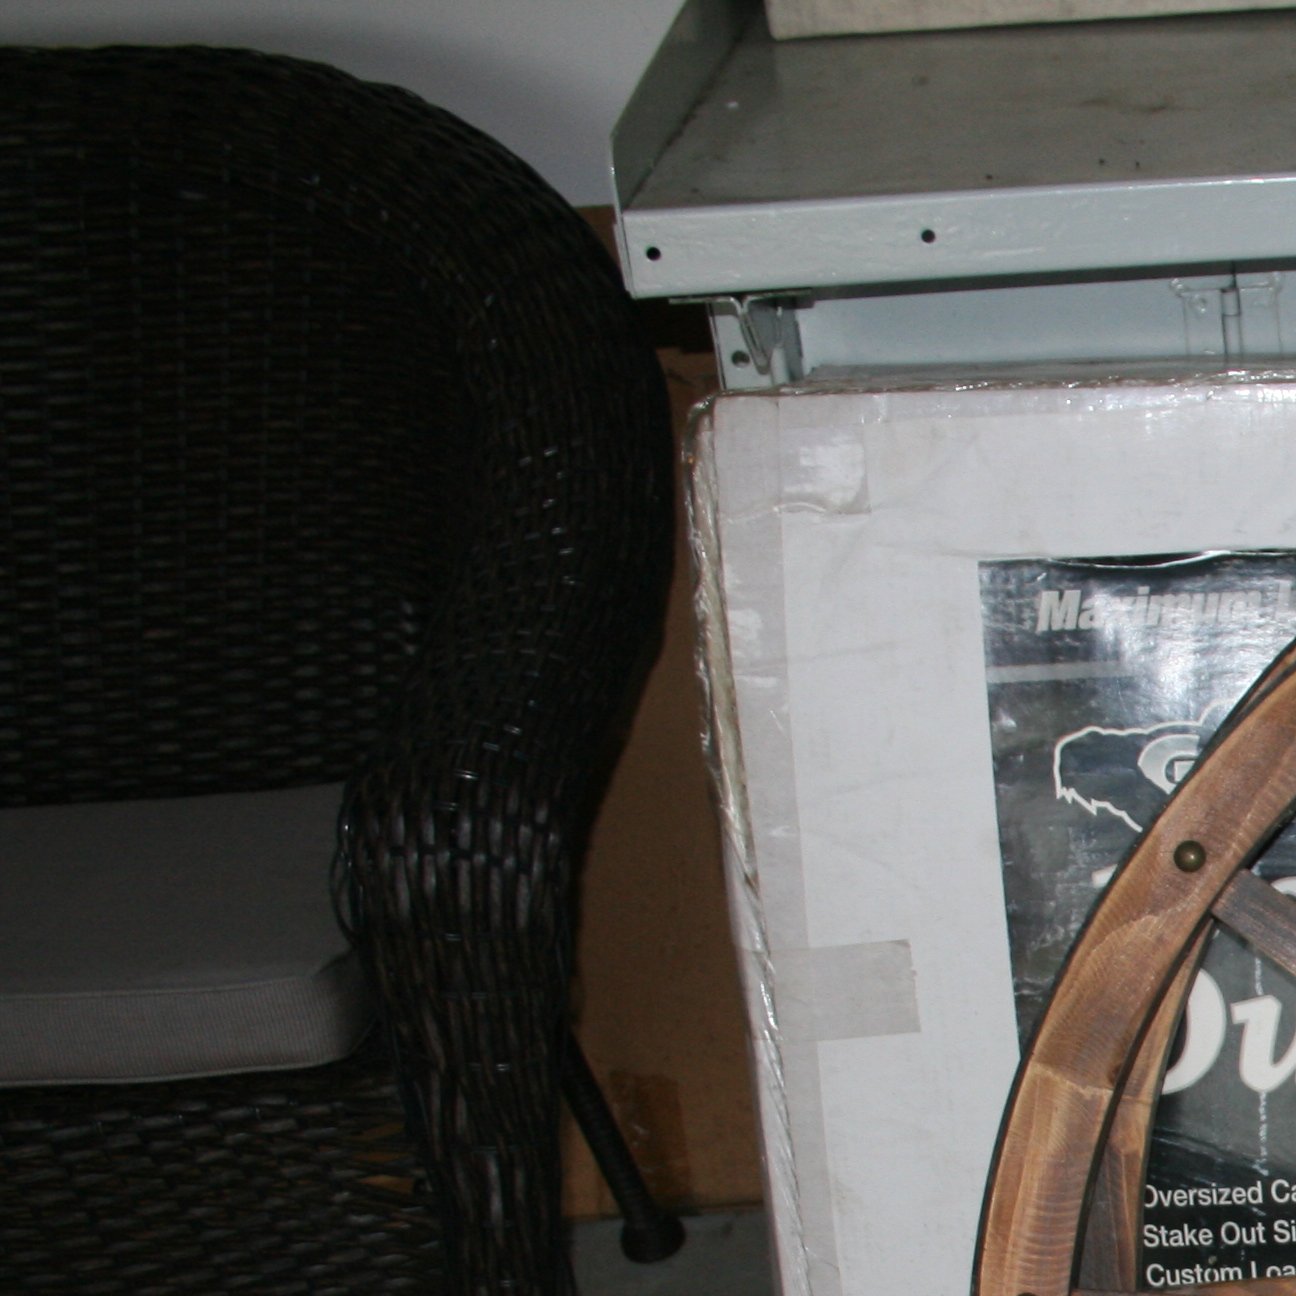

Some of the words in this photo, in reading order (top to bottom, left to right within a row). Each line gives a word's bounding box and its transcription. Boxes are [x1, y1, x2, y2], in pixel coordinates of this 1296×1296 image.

[1035, 585, 1263, 632] Maximum
[1143, 1223, 1213, 1247] Stake
[1220, 1221, 1266, 1245] Out
[1146, 1263, 1242, 1287] Custom
